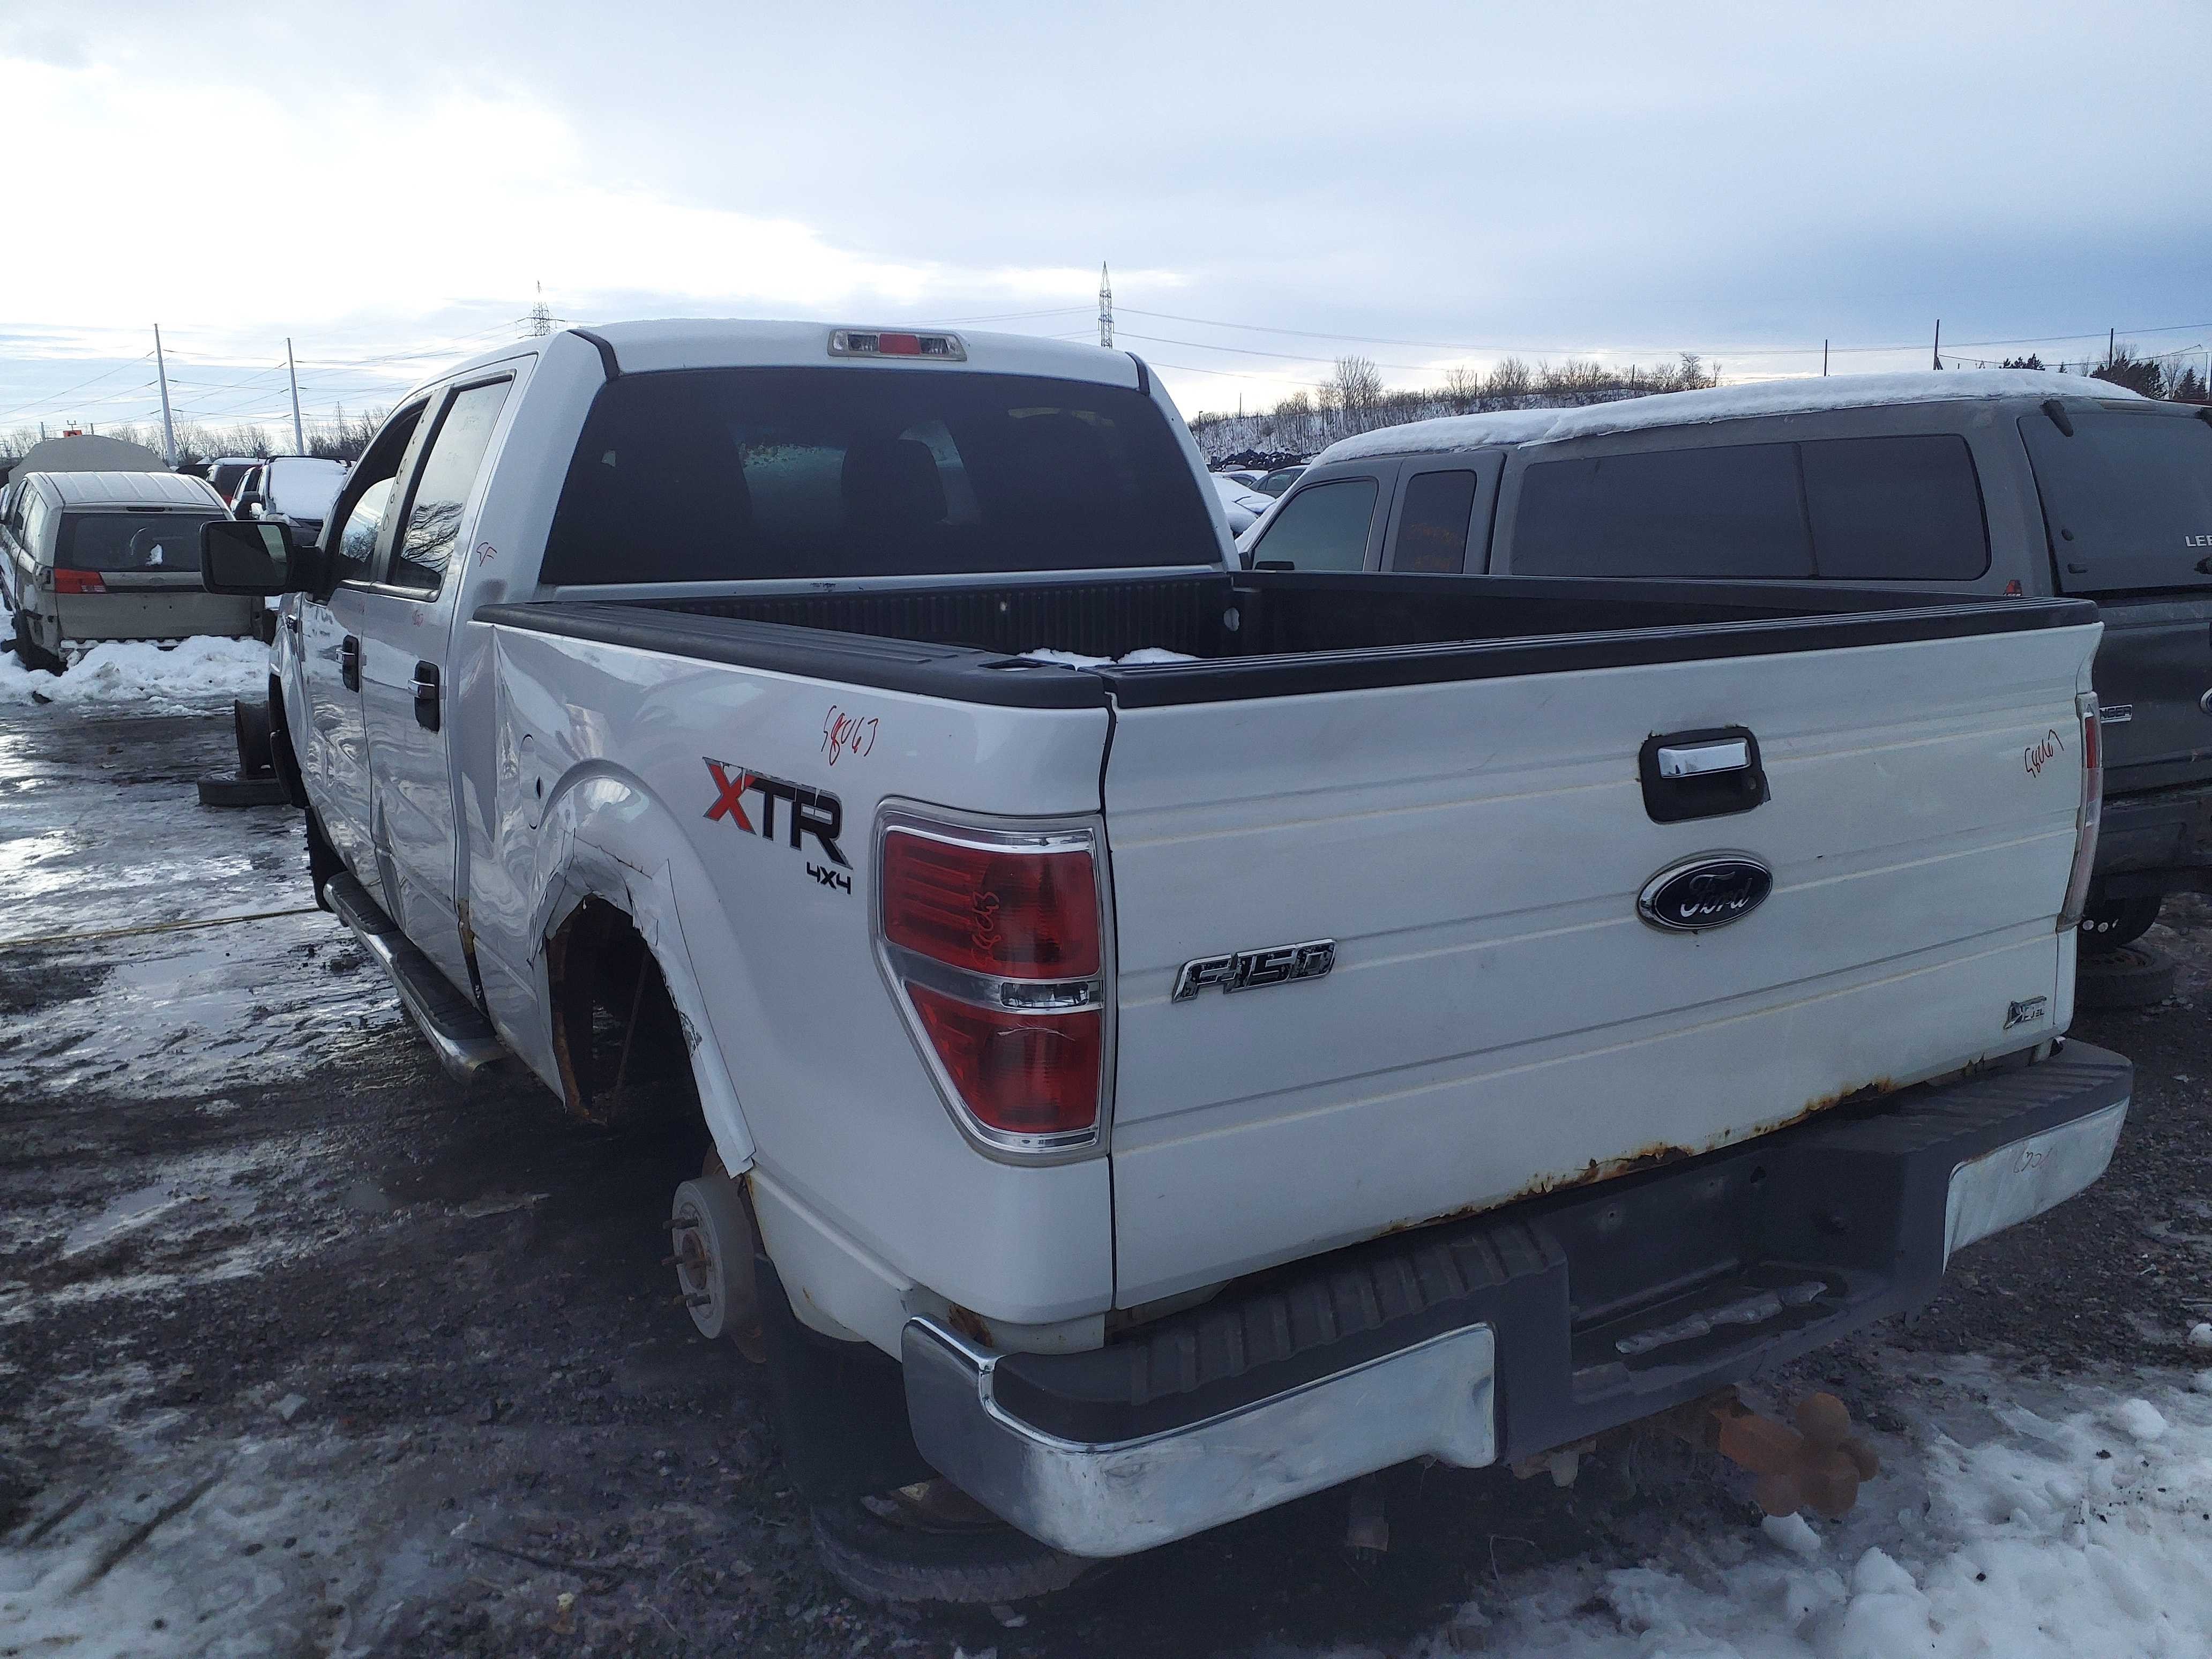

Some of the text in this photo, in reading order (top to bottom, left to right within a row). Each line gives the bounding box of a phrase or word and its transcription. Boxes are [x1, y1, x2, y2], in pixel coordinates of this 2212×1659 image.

[703, 756, 853, 869] XTR
[1680, 871, 1753, 918] Ford
[1172, 938, 1336, 1004] F-150
